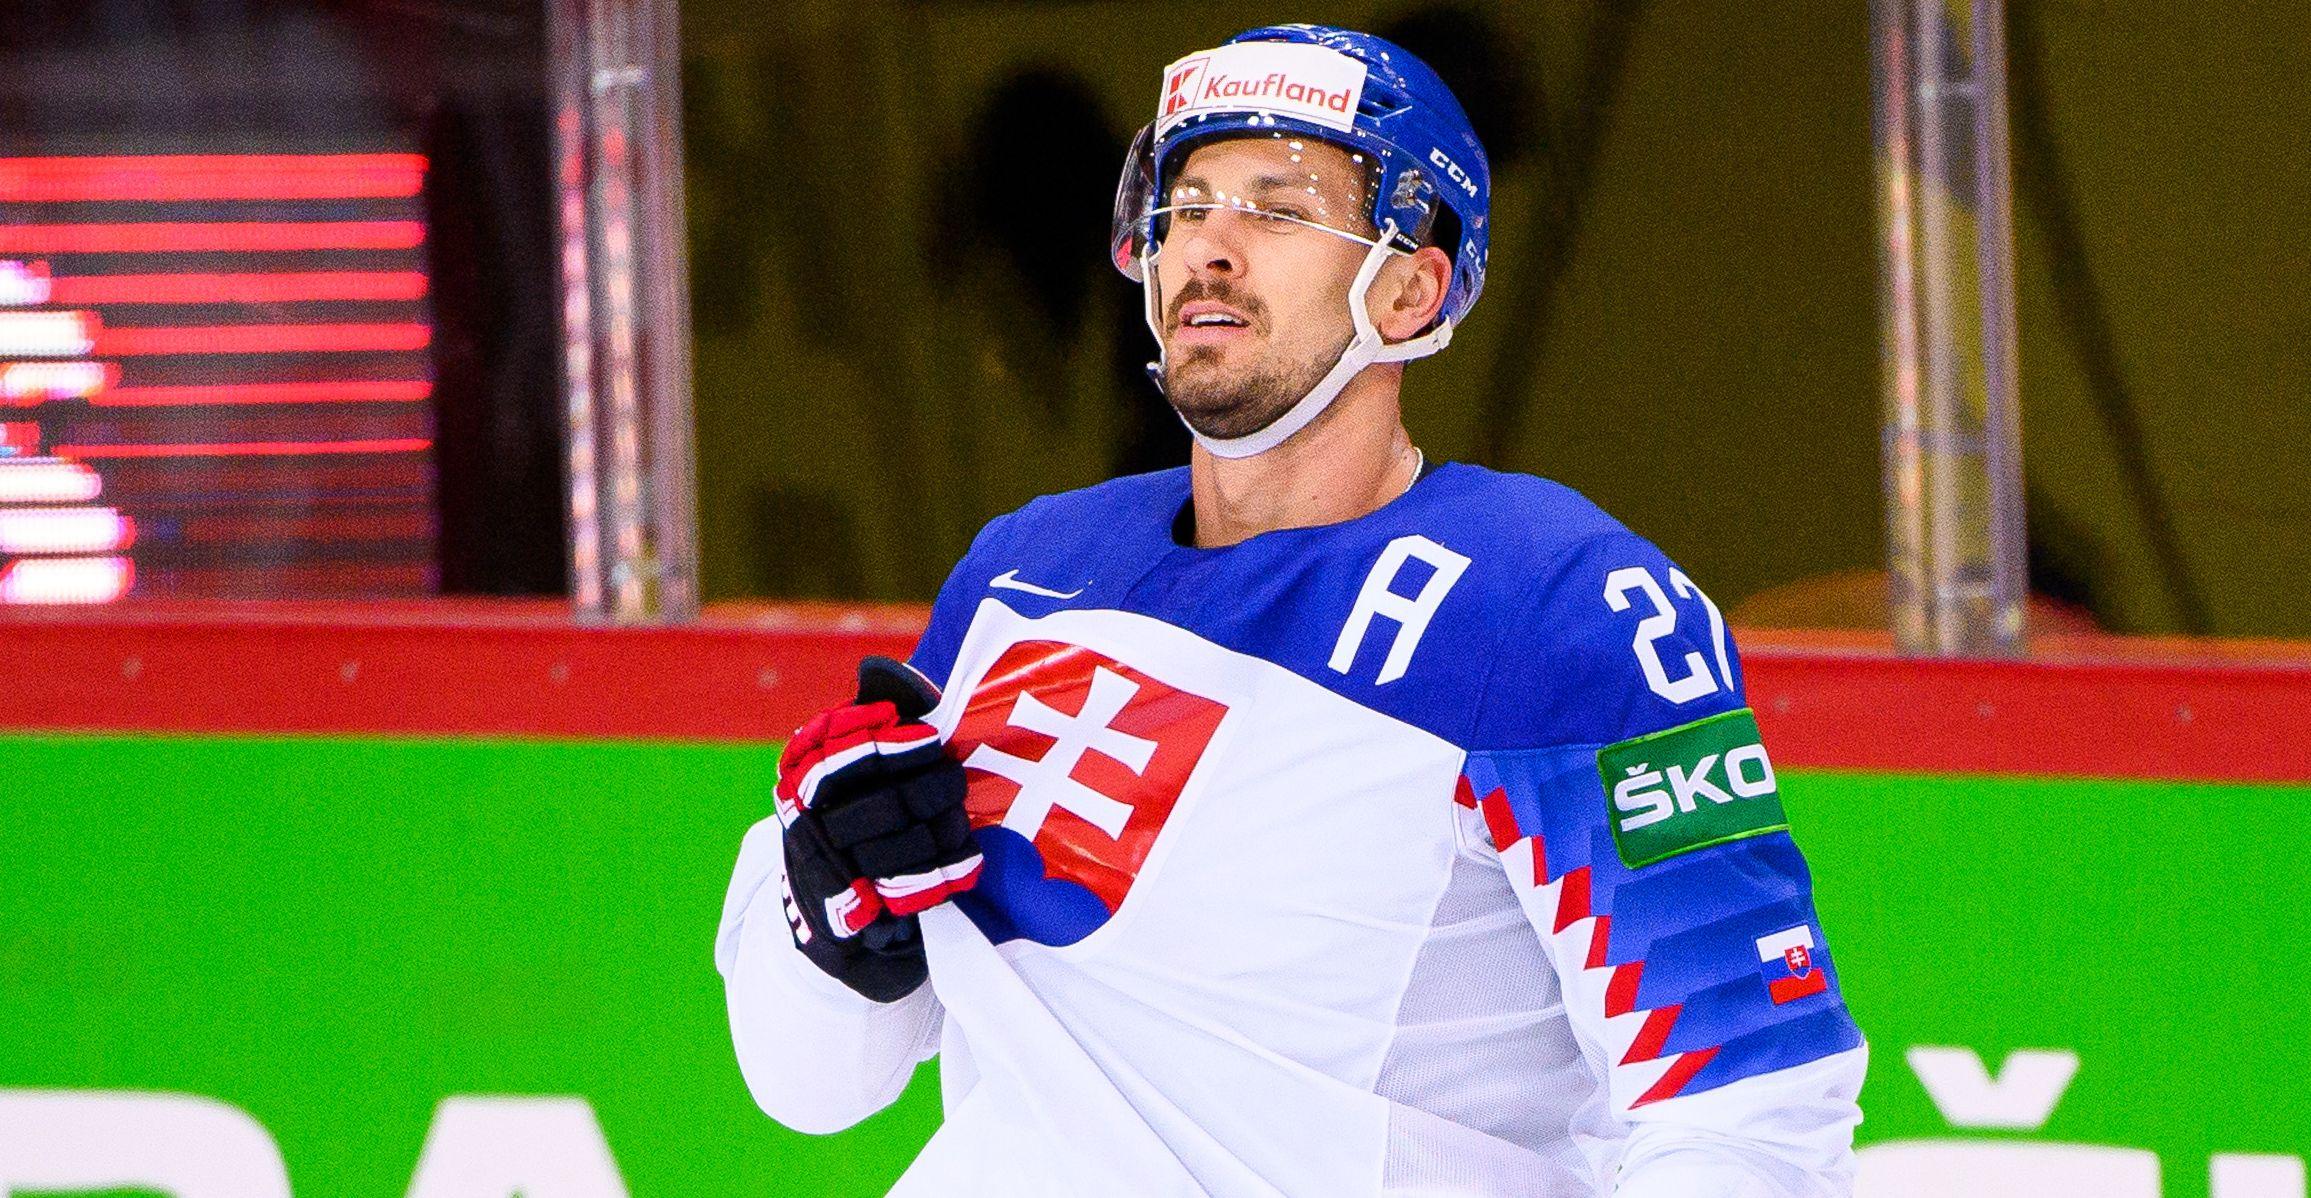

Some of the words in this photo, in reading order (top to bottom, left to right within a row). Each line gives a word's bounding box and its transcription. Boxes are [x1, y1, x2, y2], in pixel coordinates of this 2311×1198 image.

[1204, 73, 1352, 113] Kaufland
[1430, 146, 1478, 198] CCM
[1327, 534, 1472, 686] A
[1613, 743, 1777, 832] ŠKO
